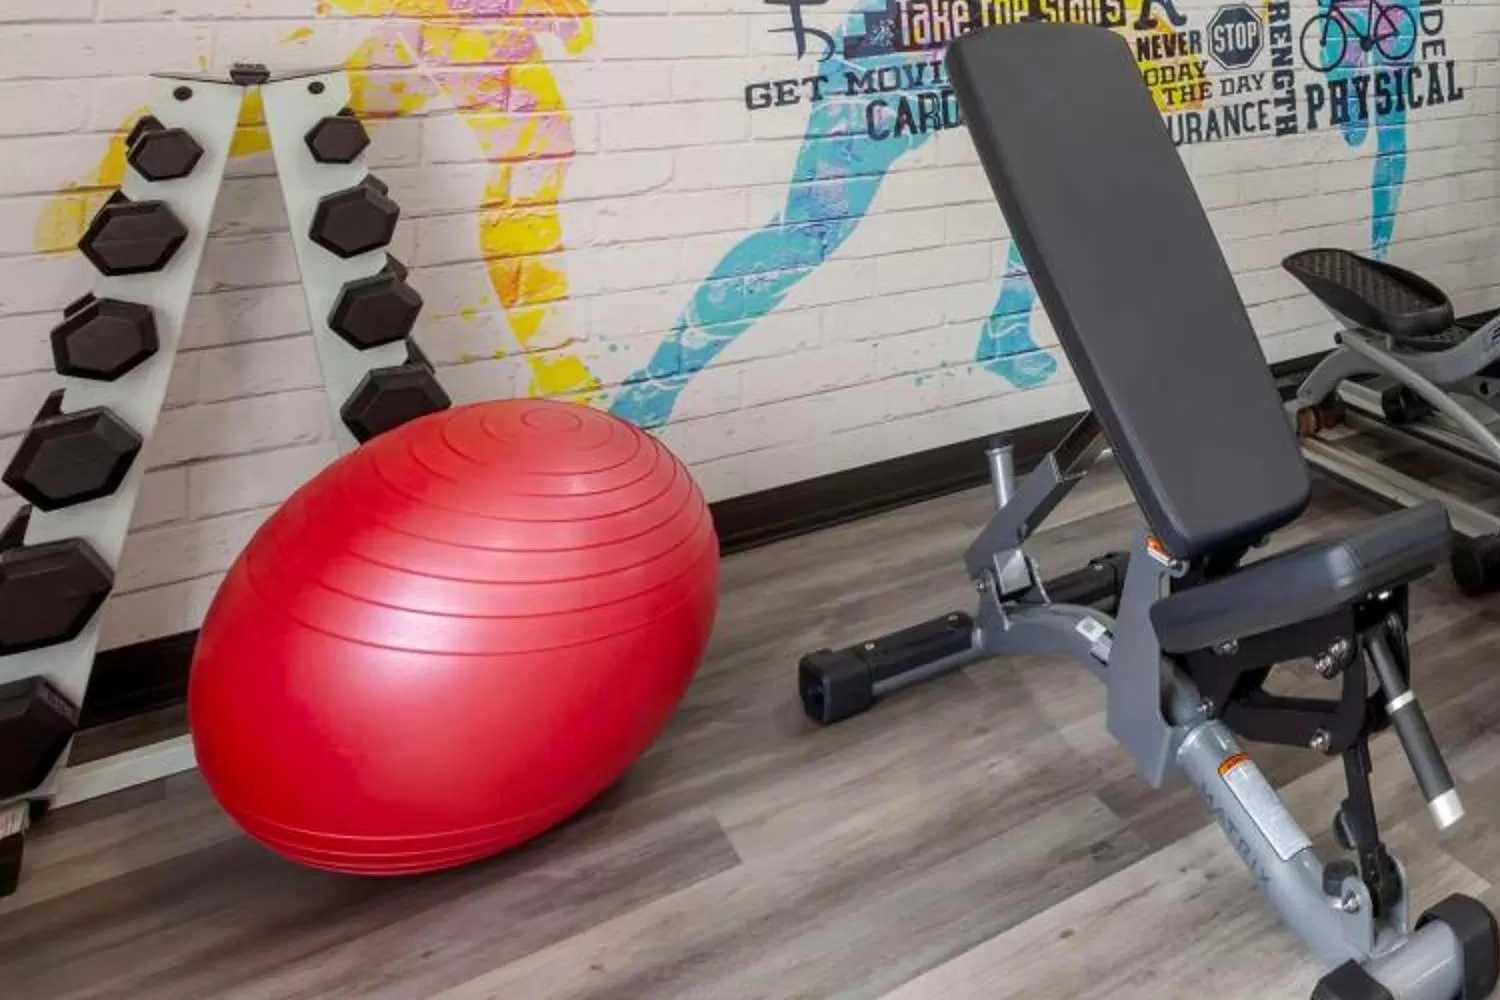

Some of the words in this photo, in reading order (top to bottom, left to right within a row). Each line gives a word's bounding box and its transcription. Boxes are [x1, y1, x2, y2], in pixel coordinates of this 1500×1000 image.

[1136, 30, 1202, 62] NEVER
[1213, 22, 1257, 53] STOP
[745, 75, 829, 111] GET
[844, 60, 951, 96] MOVI
[1143, 60, 1208, 87] ODAY
[1162, 81, 1213, 105] THE
[1220, 72, 1265, 97] DAY
[866, 89, 962, 141] CARD
[1306, 60, 1464, 130] PHYSICAL
[1166, 99, 1271, 146] URANCE
